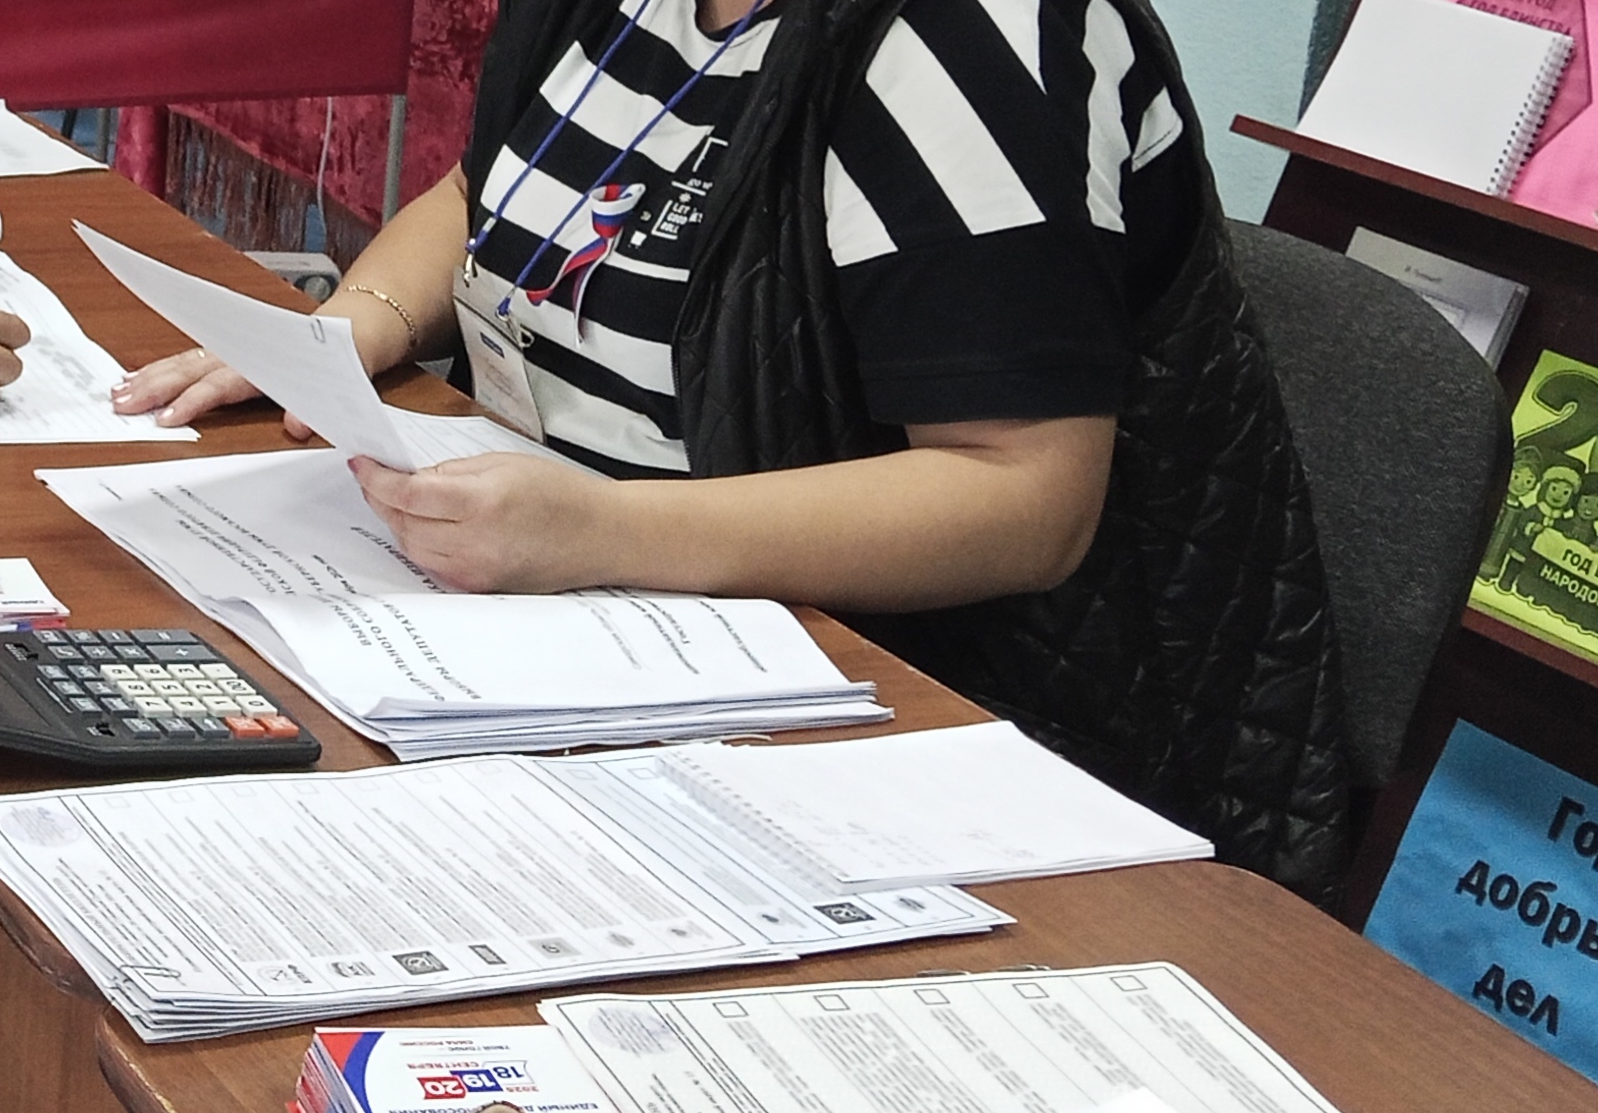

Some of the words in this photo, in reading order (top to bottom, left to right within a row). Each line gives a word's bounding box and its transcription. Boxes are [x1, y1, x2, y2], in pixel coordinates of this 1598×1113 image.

[1562, 548, 1593, 575] ГОД
[1540, 564, 1598, 604] НАРОДО
[330, 602, 372, 647] ВЫБОРЫ
[372, 626, 446, 702] ФЕДЕРАЛЬНОГО
[1548, 796, 1598, 872] Го
[1472, 963, 1560, 1037] дел
[406, 1061, 480, 1070] СЕНТЯБРЯ
[492, 1065, 524, 1079] 18
[423, 1080, 464, 1096] 20
[463, 1072, 497, 1088] 19
[536, 1102, 598, 1112] ЕДИНЫЙ
